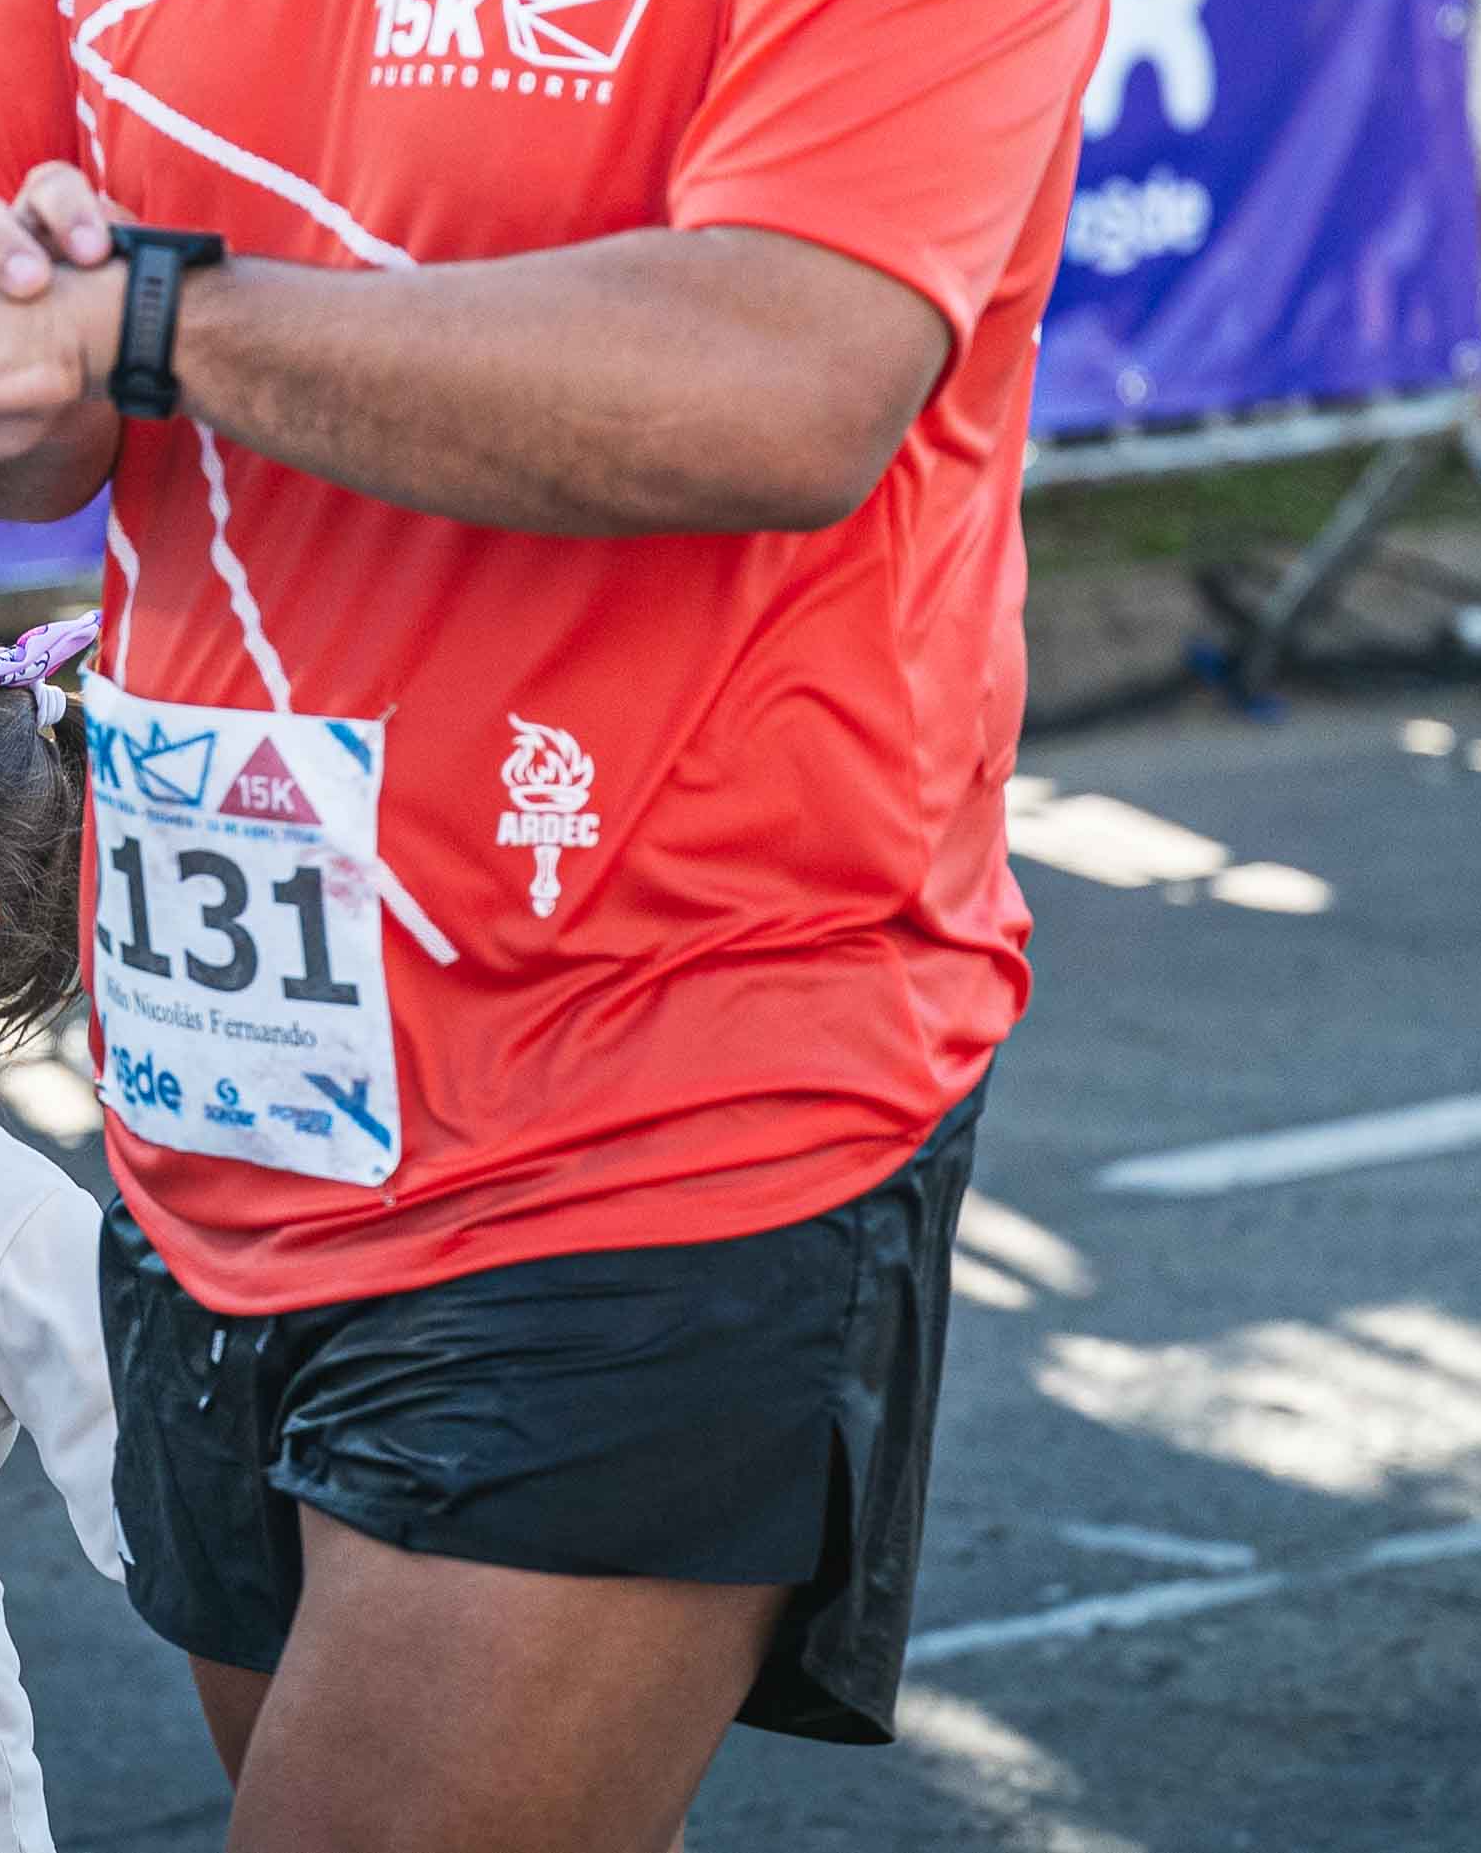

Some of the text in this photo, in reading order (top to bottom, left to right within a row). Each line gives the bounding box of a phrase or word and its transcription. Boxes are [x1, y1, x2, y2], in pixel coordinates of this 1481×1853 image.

[370, 62, 614, 106] PUERTO NORTE
[237, 775, 297, 812] 15K
[496, 811, 601, 848] ARDEC
[96, 835, 361, 1006] 131
[208, 1009, 318, 1049] Fernando
